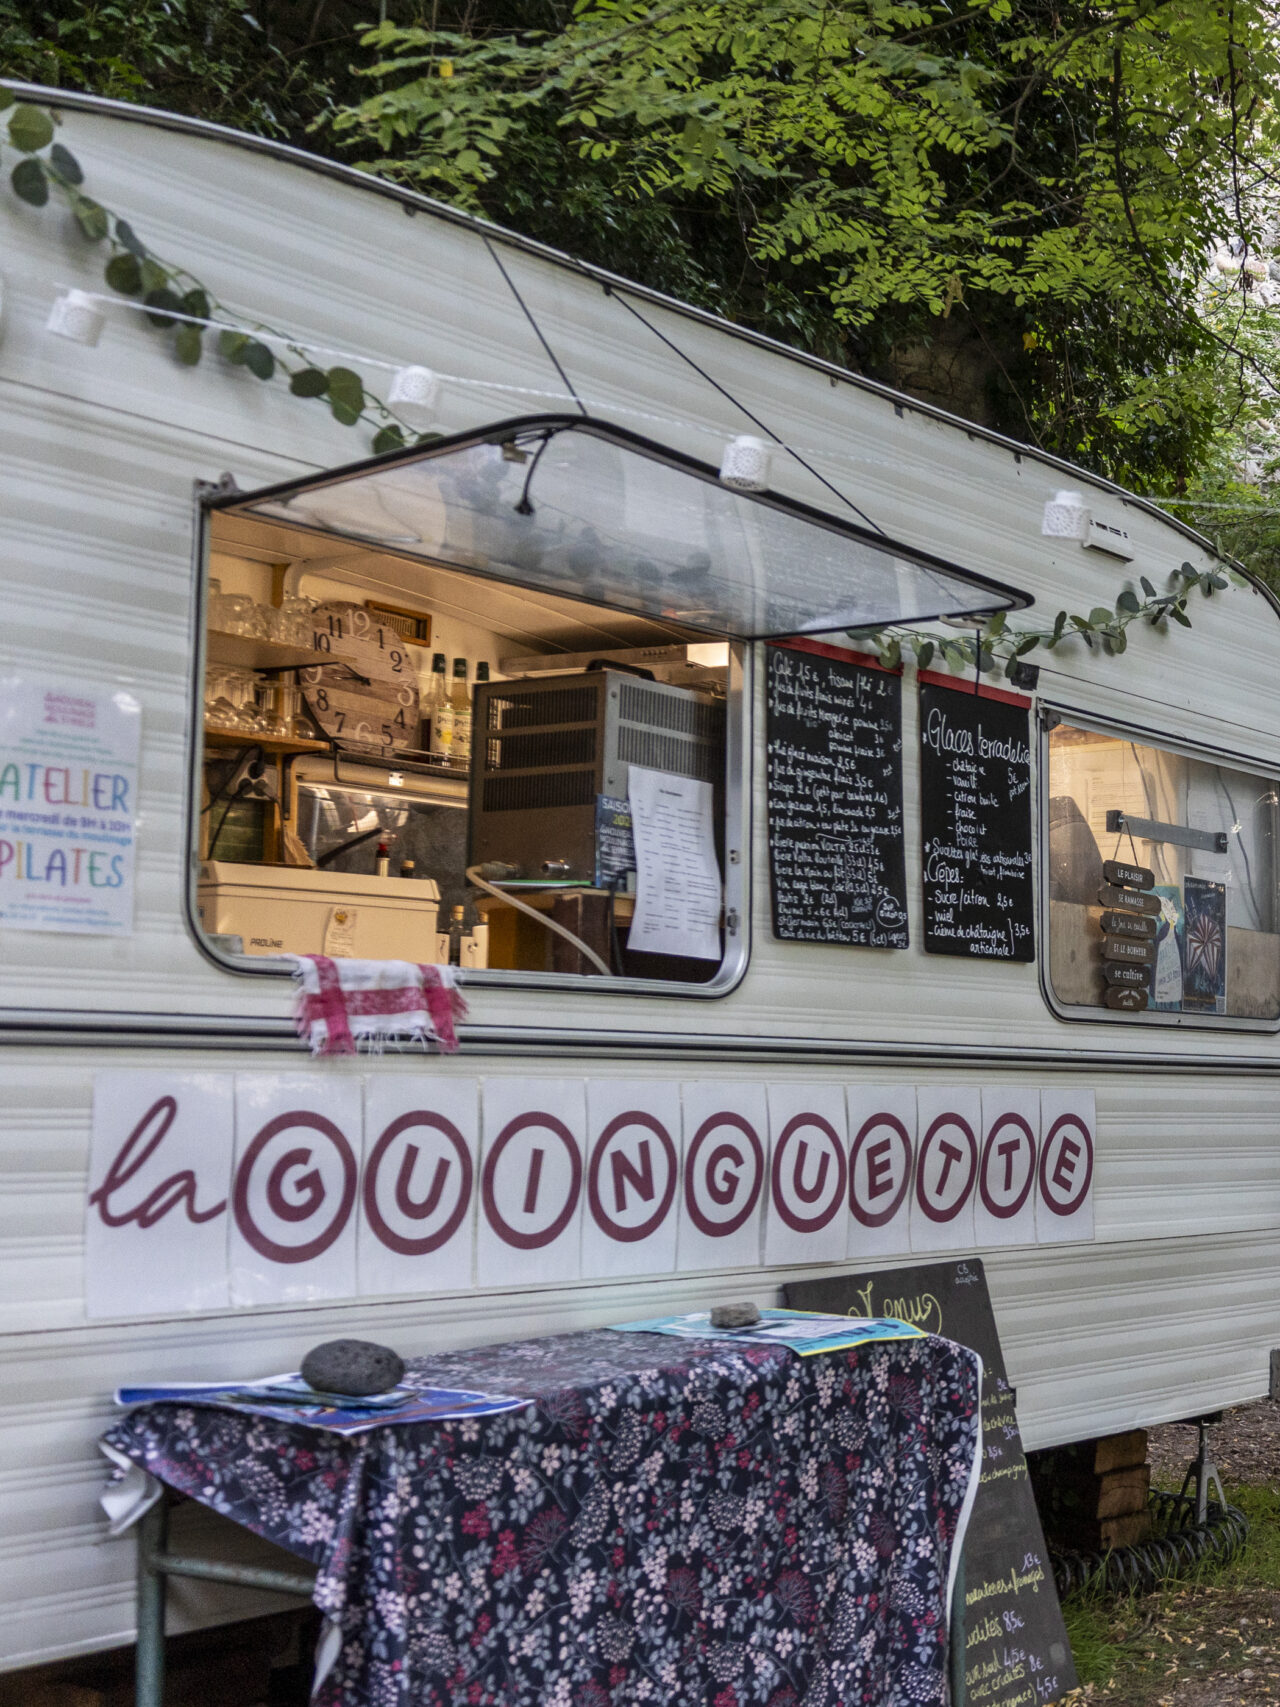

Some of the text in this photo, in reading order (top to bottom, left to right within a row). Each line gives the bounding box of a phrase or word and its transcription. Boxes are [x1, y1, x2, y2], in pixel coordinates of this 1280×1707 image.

[328, 615, 343, 639] 11
[345, 609, 371, 641] 12
[314, 632, 331, 653] 10
[376, 628, 385, 649] 1
[390, 651, 402, 673] 2
[305, 666, 322, 684] 9
[317, 689, 329, 712] 8
[398, 681, 415, 707] 3
[335, 712, 346, 733] 7
[394, 708, 406, 729] 4
[382, 724, 394, 745] 5
[927, 707, 974, 757] Glaces
[0, 763, 130, 814] ATELIER
[954, 802, 978, 821] fraise
[0, 839, 124, 888] PILATES
[1117, 868, 1144, 884] LE PLAISIR
[996, 892, 1014, 912] 2,5€
[934, 908, 955, 924] miel
[1013, 922, 1031, 940] 3,5€
[250, 938, 283, 949] PROLINE
[969, 941, 1011, 957] artisanale
[1114, 968, 1144, 982] se cultive
[91, 1094, 1089, 1248] la GUINGUETTE
[1036, 1676, 1060, 1700] 4,5€
